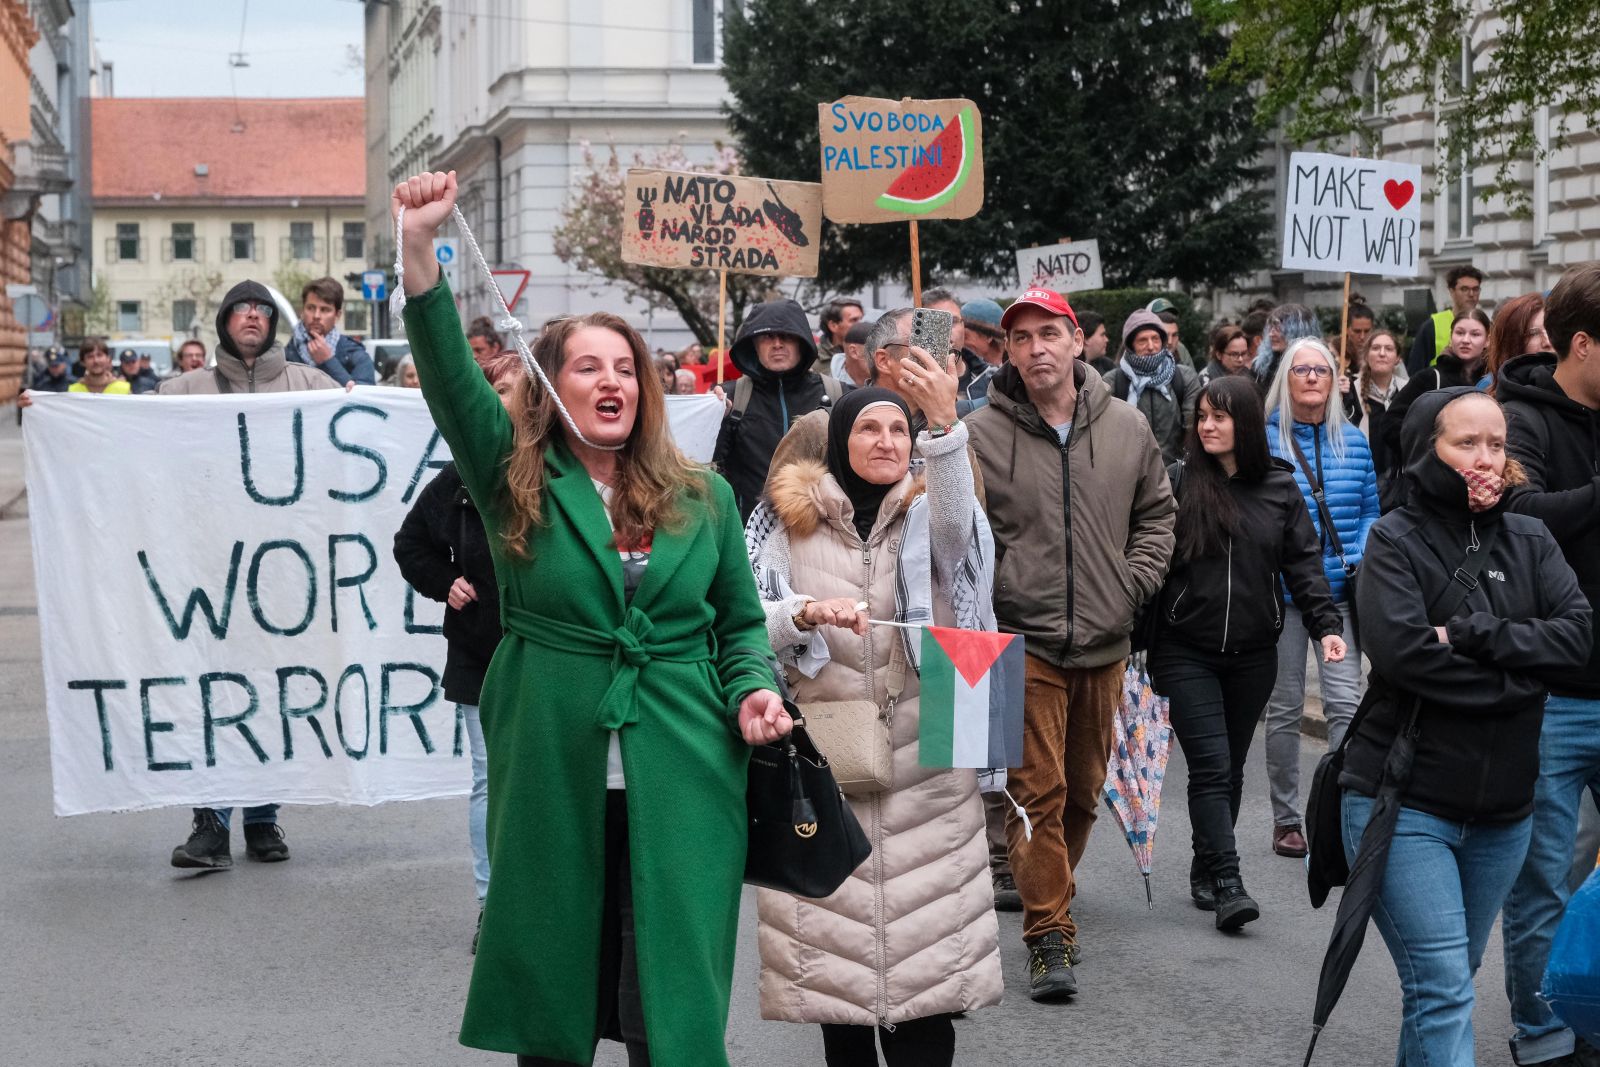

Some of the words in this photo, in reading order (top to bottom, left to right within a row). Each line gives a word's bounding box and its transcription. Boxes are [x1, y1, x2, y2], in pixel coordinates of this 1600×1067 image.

[832, 103, 944, 133] SVOBODA
[663, 176, 736, 203] NATO
[1295, 165, 1376, 210] MAKE
[690, 203, 766, 230] VLADA
[660, 218, 737, 245] NAROD
[1291, 213, 1351, 261] NOT
[1363, 217, 1415, 267] WAR
[690, 246, 779, 270] STRADA
[1036, 252, 1091, 280] NATO
